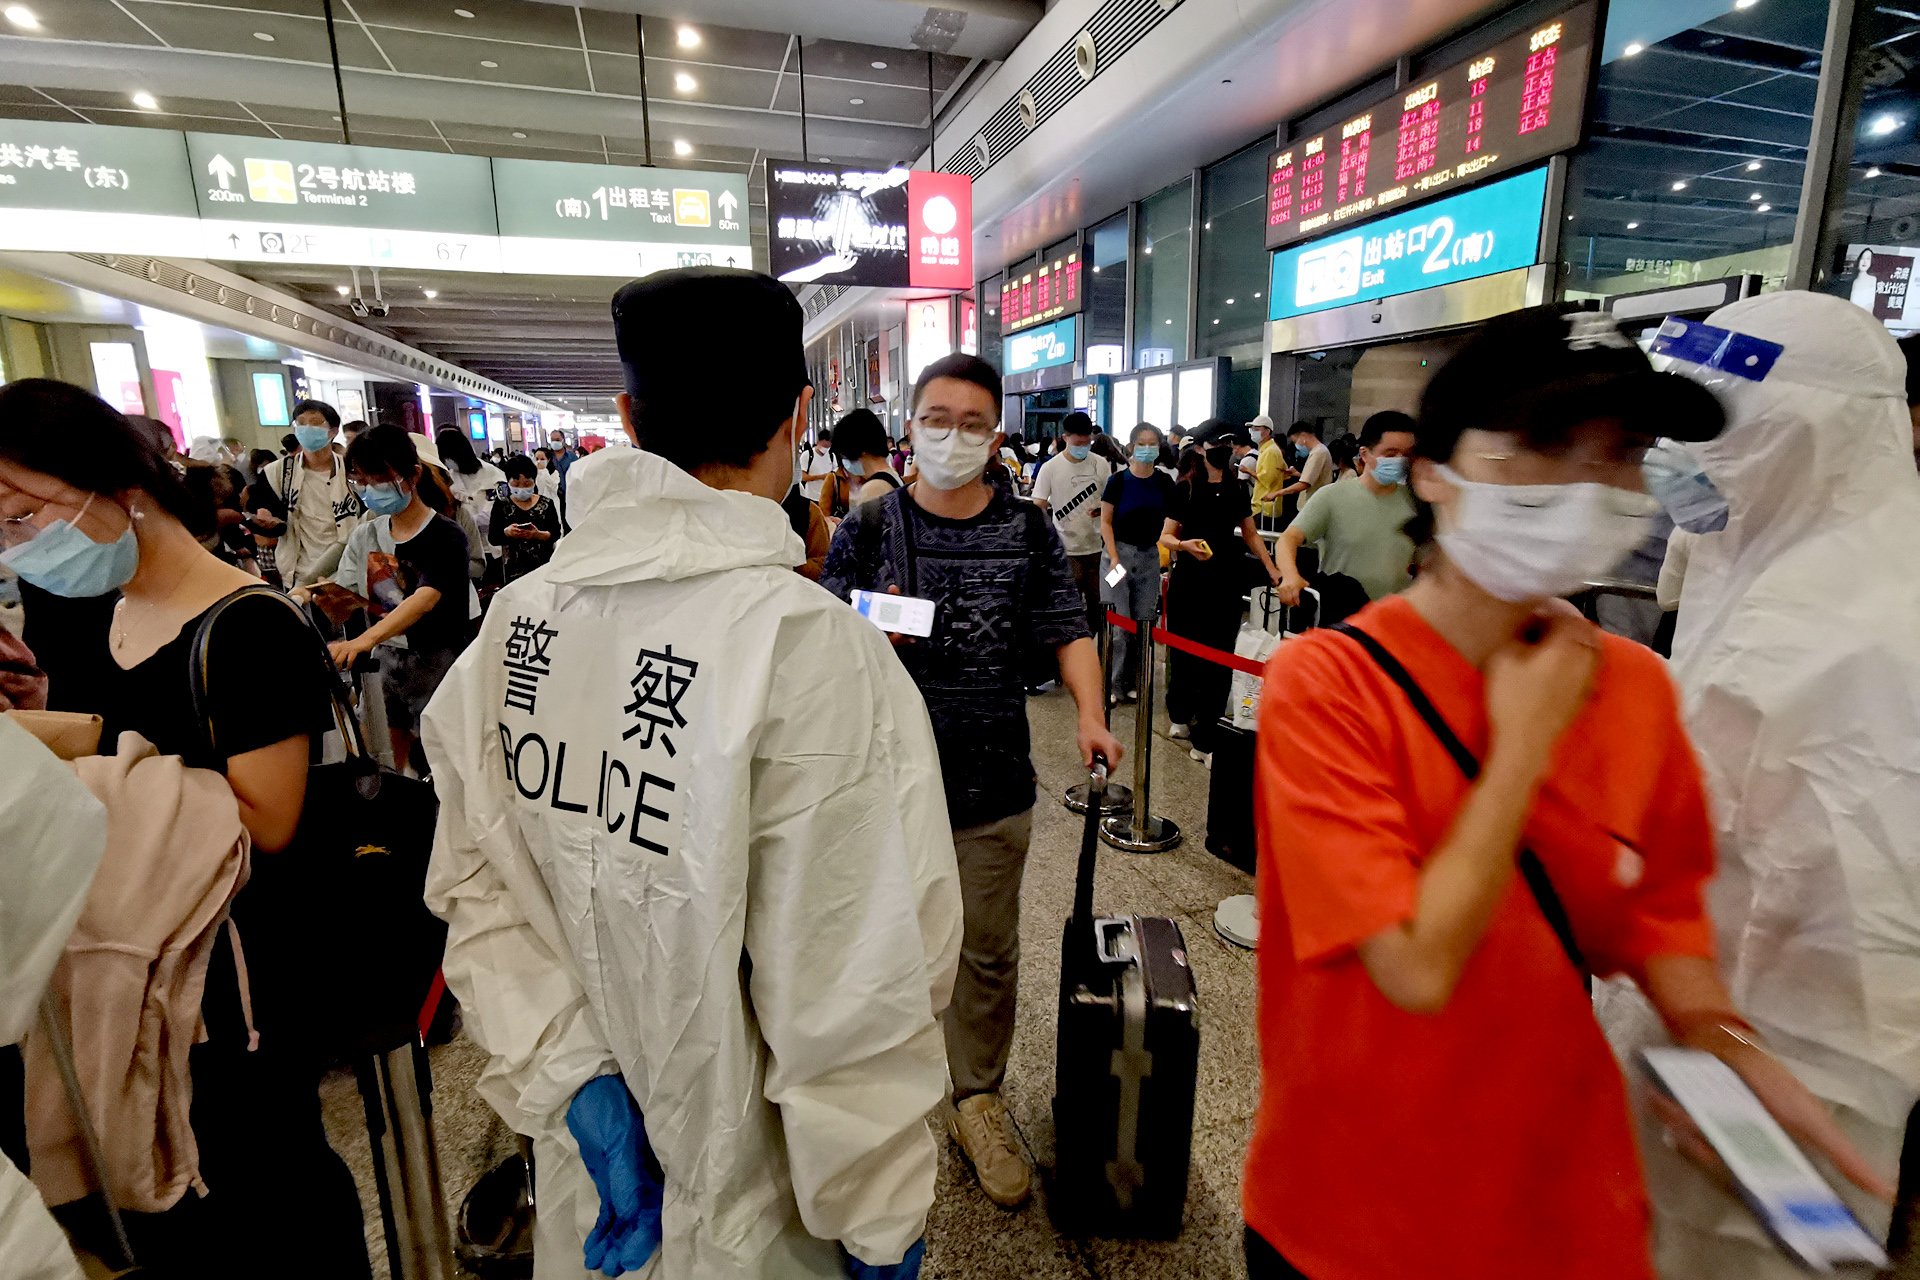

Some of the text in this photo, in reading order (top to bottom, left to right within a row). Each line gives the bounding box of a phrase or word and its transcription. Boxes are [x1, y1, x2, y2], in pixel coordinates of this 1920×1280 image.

[1404, 83, 1437, 111] 出站口
[1468, 57, 1495, 81] 站台
[1529, 23, 1562, 52] 状态
[1471, 78, 1487, 97] 15
[1525, 47, 1557, 76] 正点
[1301, 182, 1323, 200] 14:13
[1467, 117, 1483, 134] 18
[1520, 87, 1552, 114] 正点
[1302, 169, 1323, 187] 14:11
[1340, 148, 1369, 171] 北京南
[1469, 101, 1483, 118] 11
[1523, 69, 1554, 96] 正点
[1300, 197, 1322, 215] 14:16
[1465, 136, 1481, 154] 14
[1518, 109, 1549, 135] 正点
[297, 163, 416, 195] 2号航站楼
[208, 189, 245, 203] 200m
[301, 190, 369, 207] Terminal 2
[650, 212, 672, 224] Taxi
[719, 219, 740, 231] 50m
[288, 233, 319, 254] 2F
[1362, 269, 1385, 289] Exit
[1088, 384, 1098, 397] B1
[503, 615, 699, 758] 警察
[498, 721, 676, 857] POLICE
